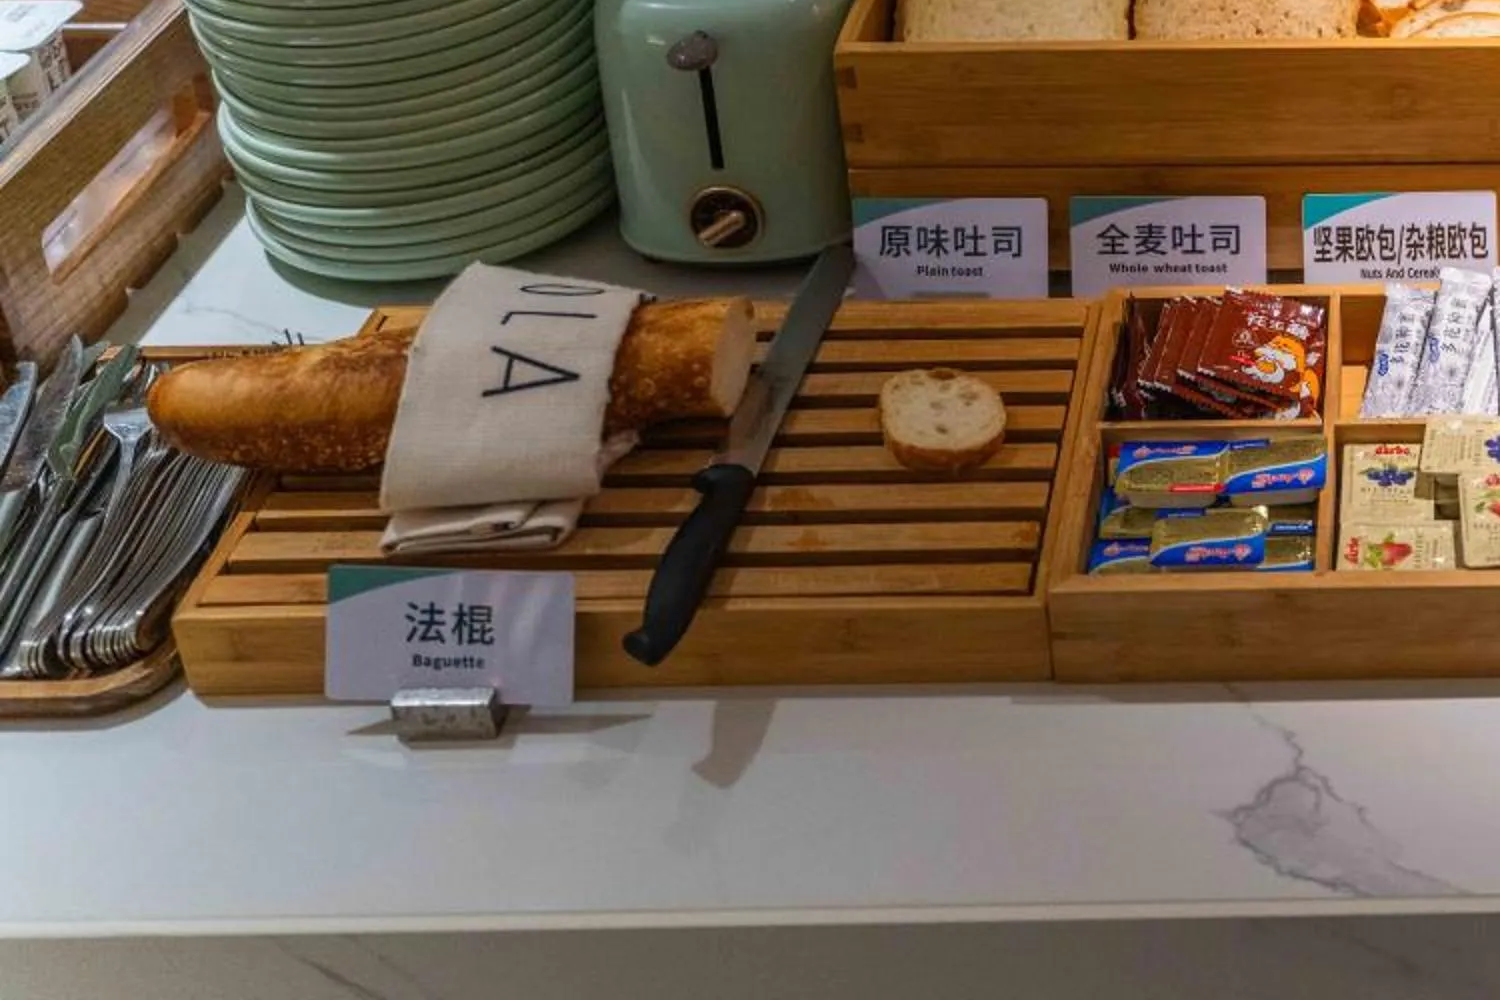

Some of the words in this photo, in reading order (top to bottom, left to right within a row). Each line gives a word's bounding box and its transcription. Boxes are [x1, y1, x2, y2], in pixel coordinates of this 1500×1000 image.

[879, 224, 1023, 258] 原味吐司
[1096, 223, 1241, 255] 全麦吐司
[1312, 221, 1489, 264] 坚果欧包/杂粮欧包
[916, 265, 949, 277] Plain
[1109, 262, 1149, 273] Whole
[1153, 262, 1193, 273] wheat
[1194, 262, 1228, 273] toast
[1360, 267, 1383, 280] Nuts
[1386, 266, 1405, 280] And
[404, 601, 497, 647] 法棍
[411, 653, 486, 671] Baguette
